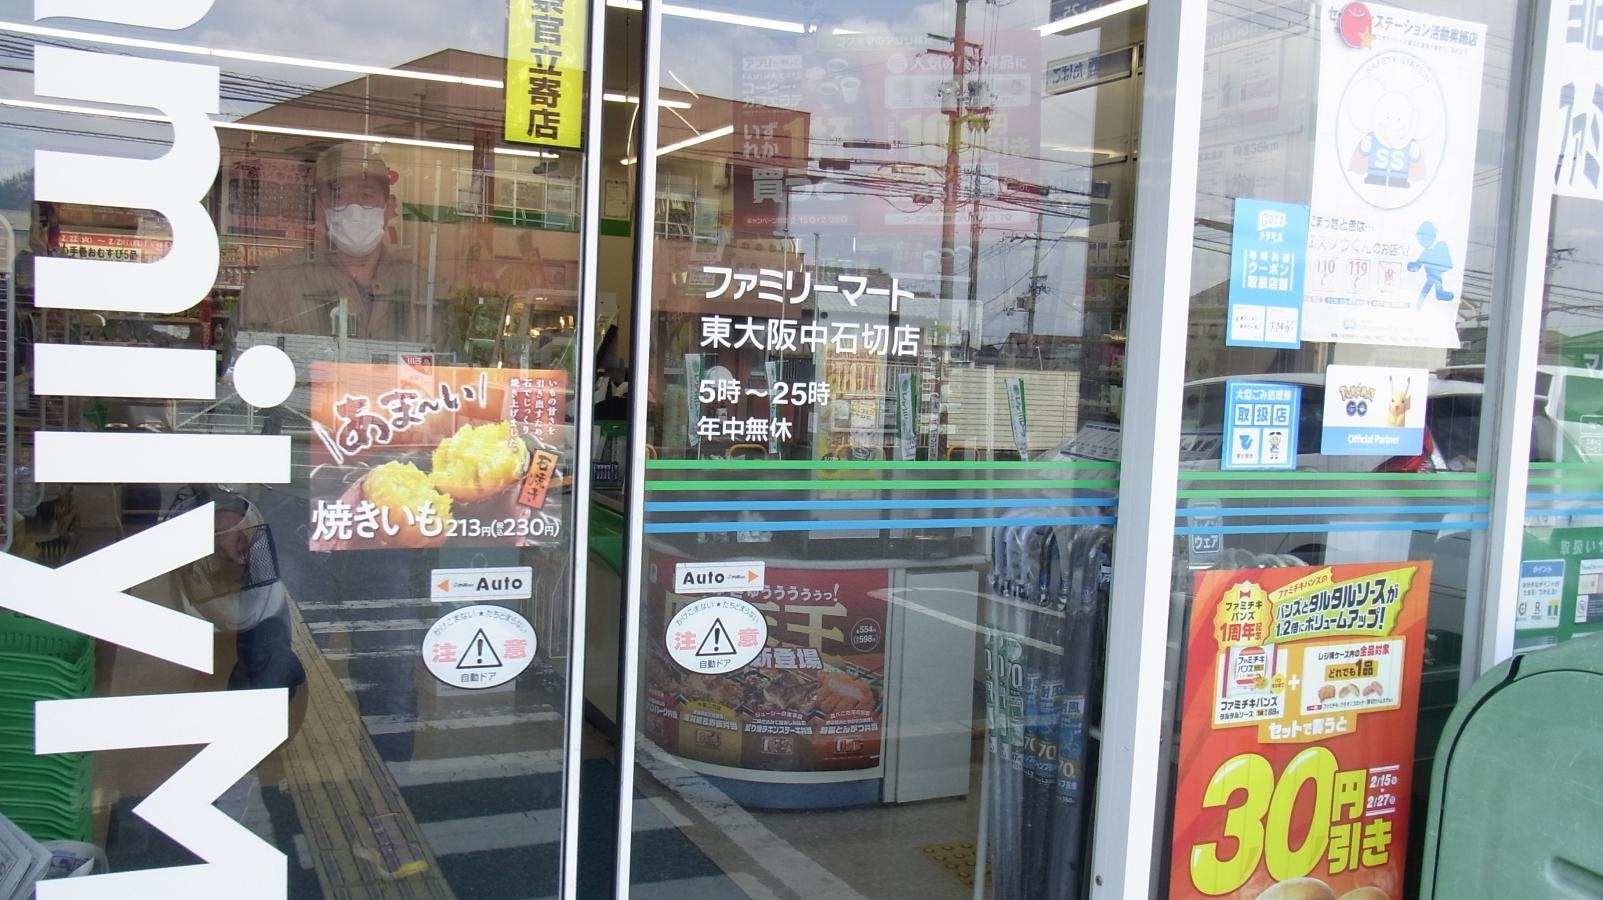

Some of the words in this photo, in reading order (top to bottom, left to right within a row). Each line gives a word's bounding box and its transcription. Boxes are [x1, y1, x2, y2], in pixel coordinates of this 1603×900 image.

[1374, 148, 1406, 170] SS
[1248, 262, 1289, 276] クーポン
[1317, 260, 1336, 273] 110
[1350, 260, 1368, 276] 119
[703, 266, 915, 312] ファミリーマート
[700, 315, 921, 357] 東大阪中石切店
[522, 378, 532, 435] 石でじっくり
[548, 379, 557, 434] いもの甘さを
[1237, 407, 1289, 423] 取扱店
[1346, 400, 1368, 416] GO
[697, 416, 793, 442] 年中無休
[1347, 434, 1373, 444] Official
[1374, 435, 1401, 445] Partner
[312, 500, 442, 541] 焼きいも
[1194, 536, 1218, 550] ウェア
[476, 577, 523, 591] Auto
[682, 571, 725, 585] Auto
[1225, 600, 1263, 612] ファミチキ
[1276, 579, 1399, 619] バンズとタルタルソースが
[1231, 610, 1255, 621] バンズ
[1275, 609, 1385, 636] 1.2倍にボリュームアップ!
[674, 631, 697, 651] 注
[737, 628, 760, 647] 意
[433, 642, 457, 663] 注
[504, 639, 528, 659] 意
[699, 659, 731, 669] 自動ドア
[1327, 659, 1374, 678] どれでも1品
[461, 672, 497, 682] 自動ドア
[1220, 696, 1279, 711] ファミチキバンズ
[1219, 710, 1254, 721] タルタルソース
[1269, 716, 1348, 740] セットで買うと
[1038, 741, 1057, 760] 70
